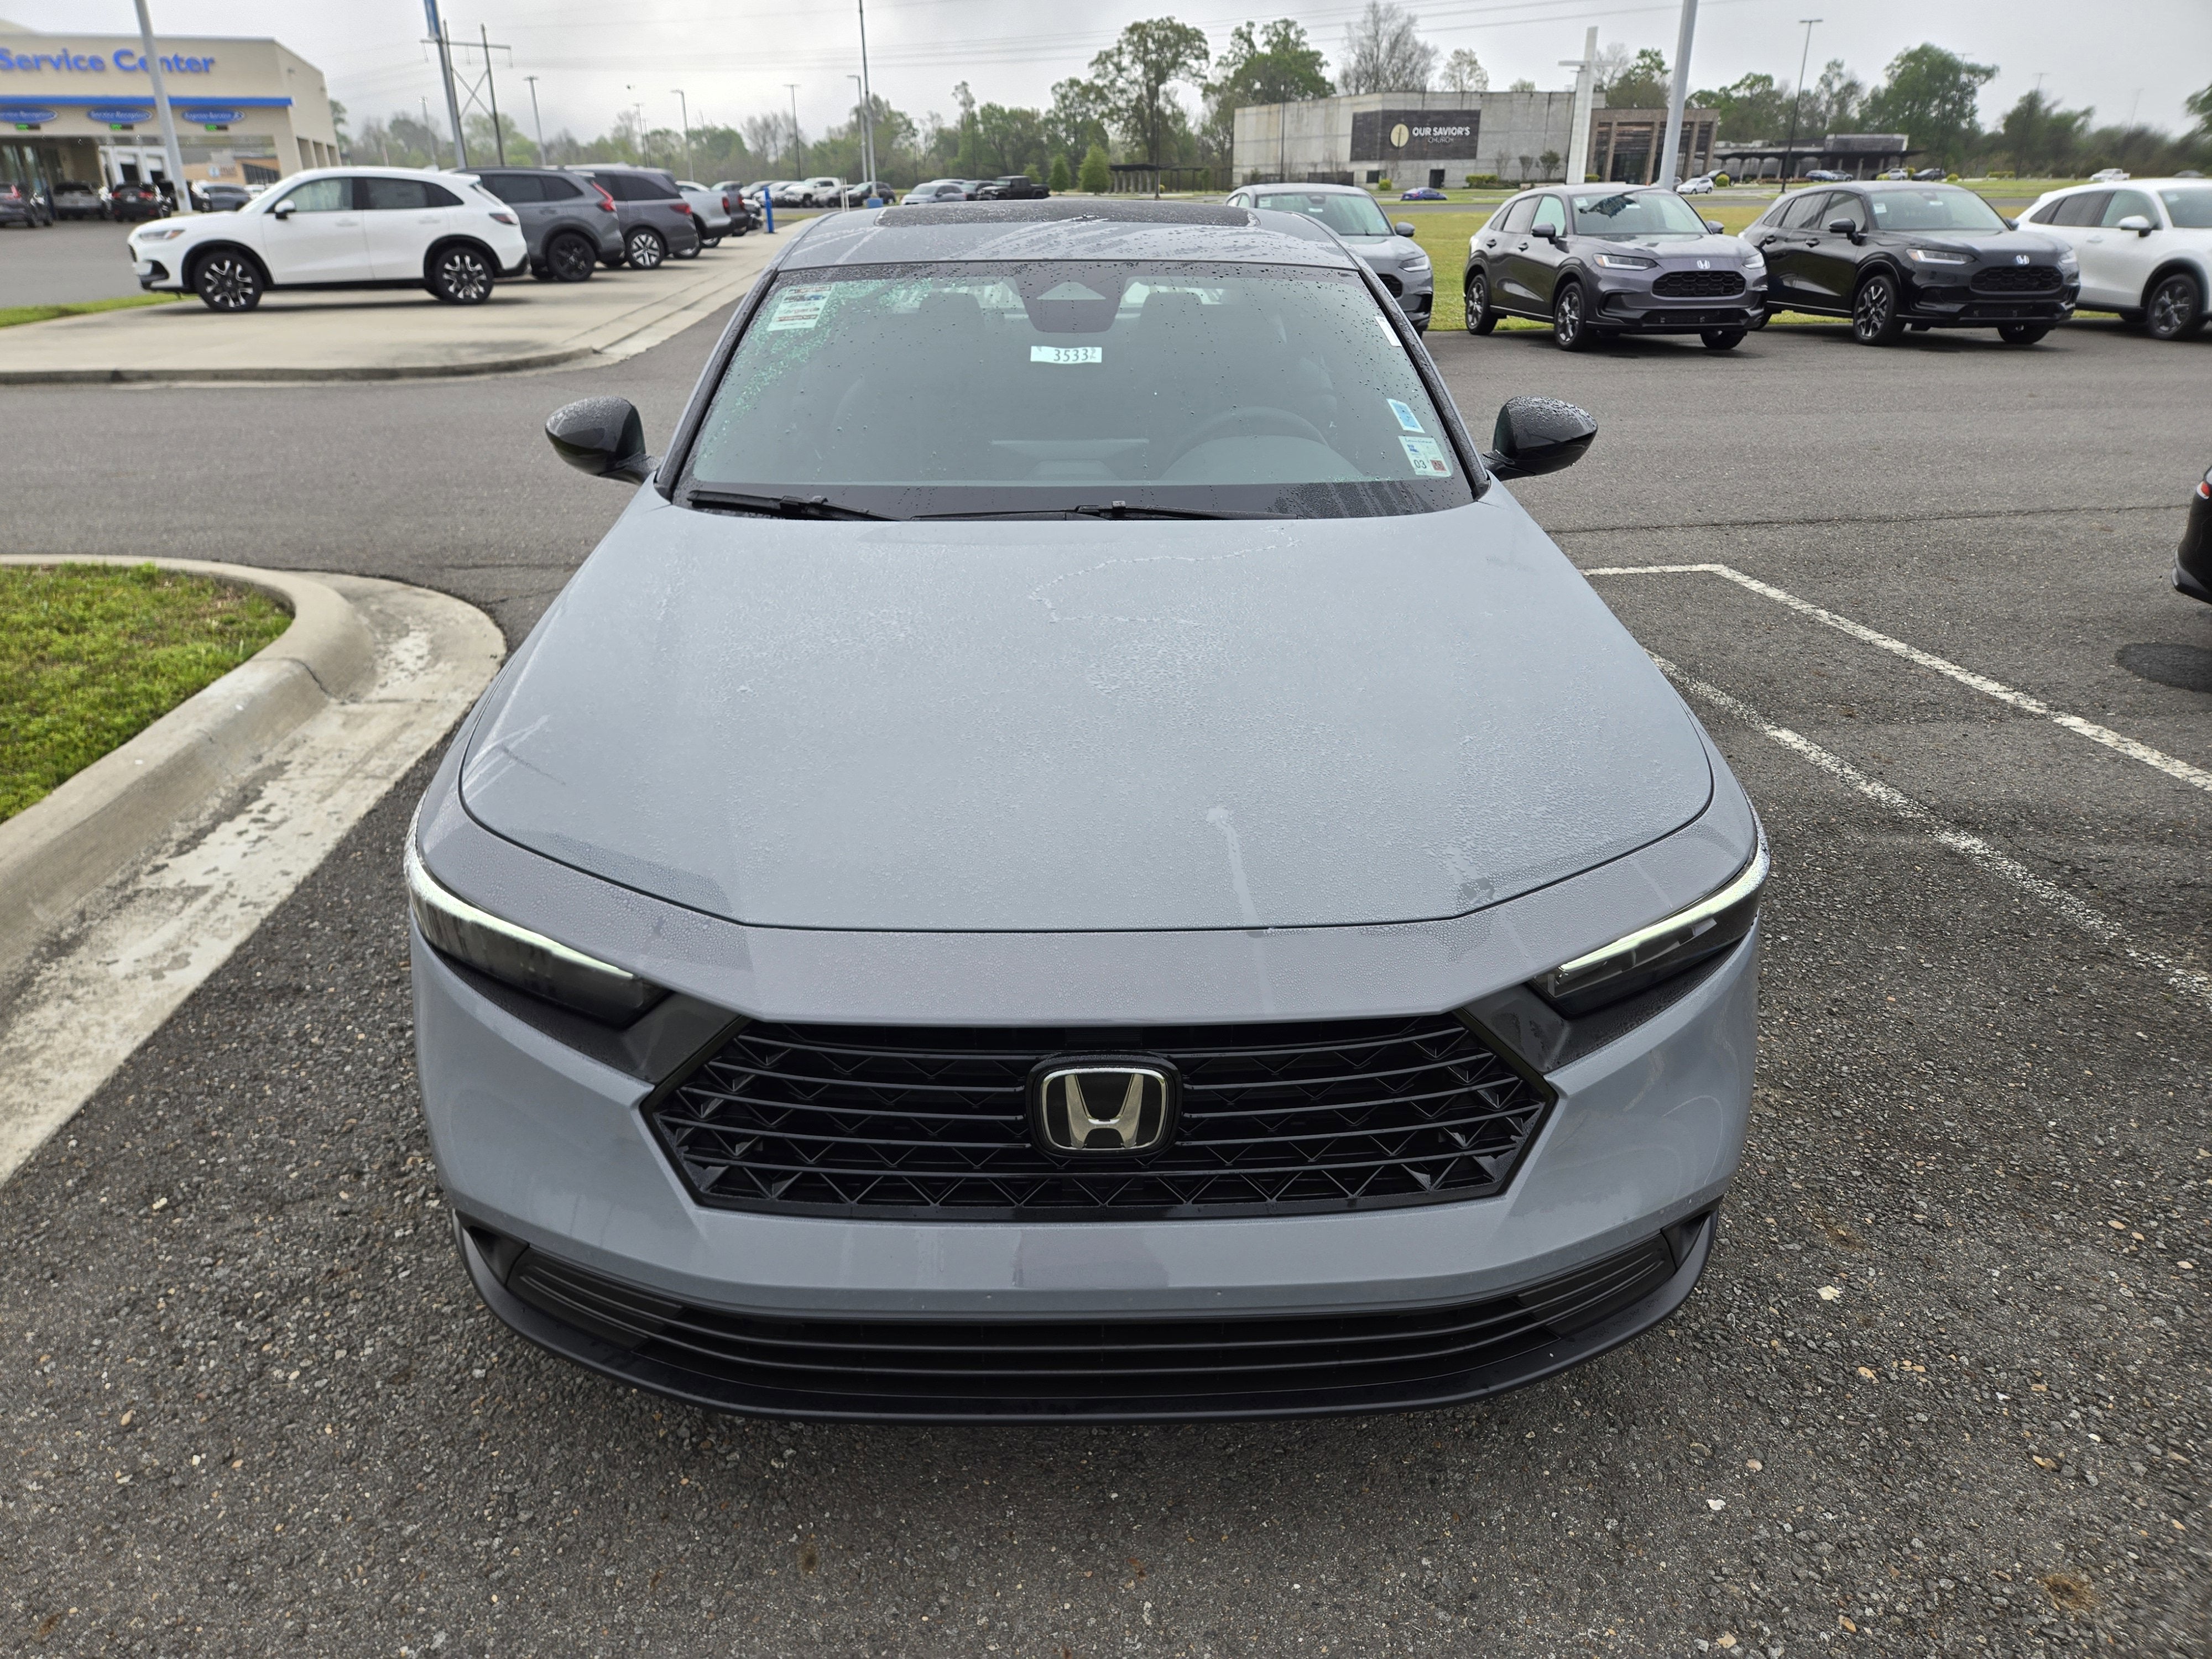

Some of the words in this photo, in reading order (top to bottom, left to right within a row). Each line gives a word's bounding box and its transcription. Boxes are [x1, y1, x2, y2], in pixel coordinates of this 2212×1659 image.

[0, 48, 106, 71] Service
[112, 49, 215, 73] Center
[1412, 127, 1432, 137] OUR
[1432, 127, 1470, 137] SAVIOR'S
[1413, 459, 1427, 469] 03
